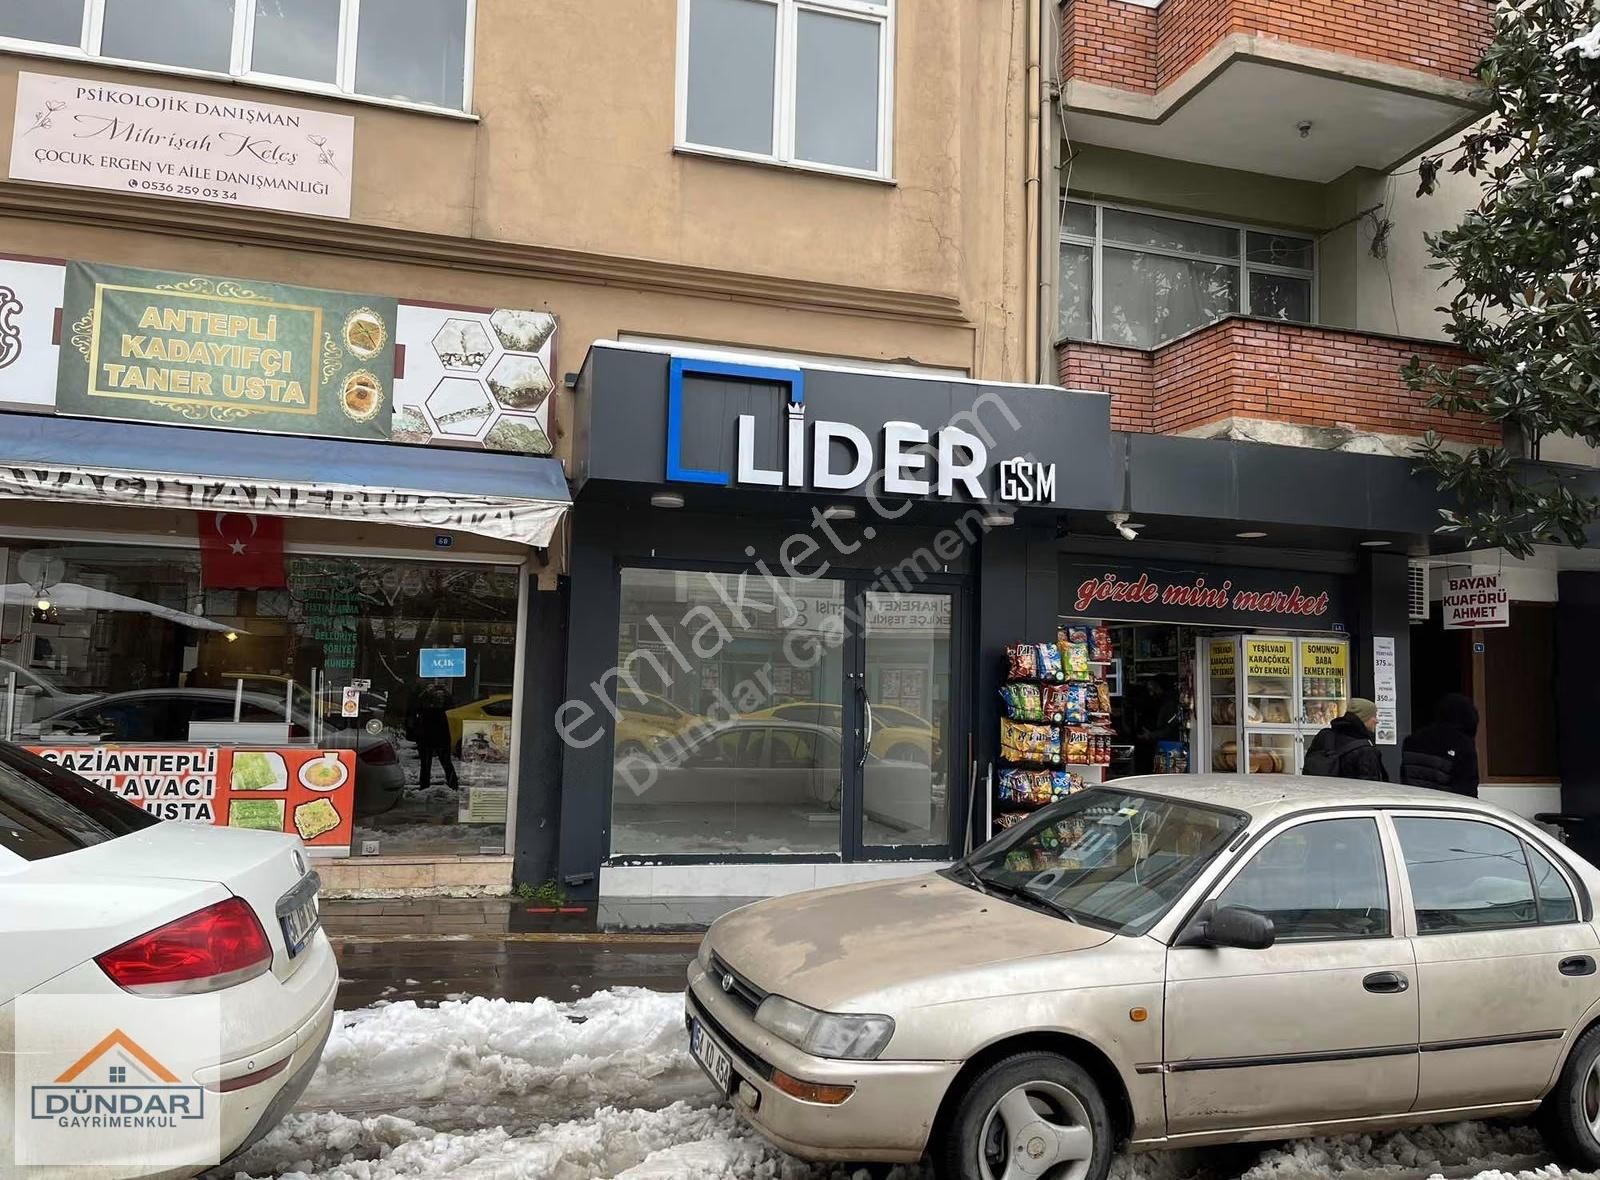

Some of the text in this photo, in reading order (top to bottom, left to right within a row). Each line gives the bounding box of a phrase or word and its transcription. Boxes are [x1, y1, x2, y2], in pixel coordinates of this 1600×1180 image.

[77, 87, 300, 128] PSİKOLOJİK DANIŞMAN
[73, 114, 298, 165] Mihrişah Keleş
[101, 156, 151, 172] ERGEN
[157, 162, 175, 175] VE
[178, 164, 211, 179] AİLE
[216, 170, 329, 195] DANIŞMANLIĞI
[142, 181, 237, 200] 0536 259 03 34
[138, 306, 277, 341] ANTEPLİ
[121, 334, 292, 375] KADAYIFÇI
[104, 363, 306, 404] TANER USTA
[1000, 457, 1056, 502] GSM
[1449, 576, 1497, 591] BAYAN
[1074, 573, 1329, 615] gözde mini market
[1443, 588, 1507, 607] KUAFÖRÜ
[1452, 606, 1497, 619] AHMET
[1253, 644, 1287, 655] YEŞİLVADİ
[1307, 644, 1340, 655] SOMUNCU
[1248, 655, 1291, 666] KARAÇÖKEK
[1315, 655, 1332, 665] BABA
[1249, 665, 1290, 675] KÖY EKMEĞİ
[1303, 667, 1344, 677] EKMEK FIRINI
